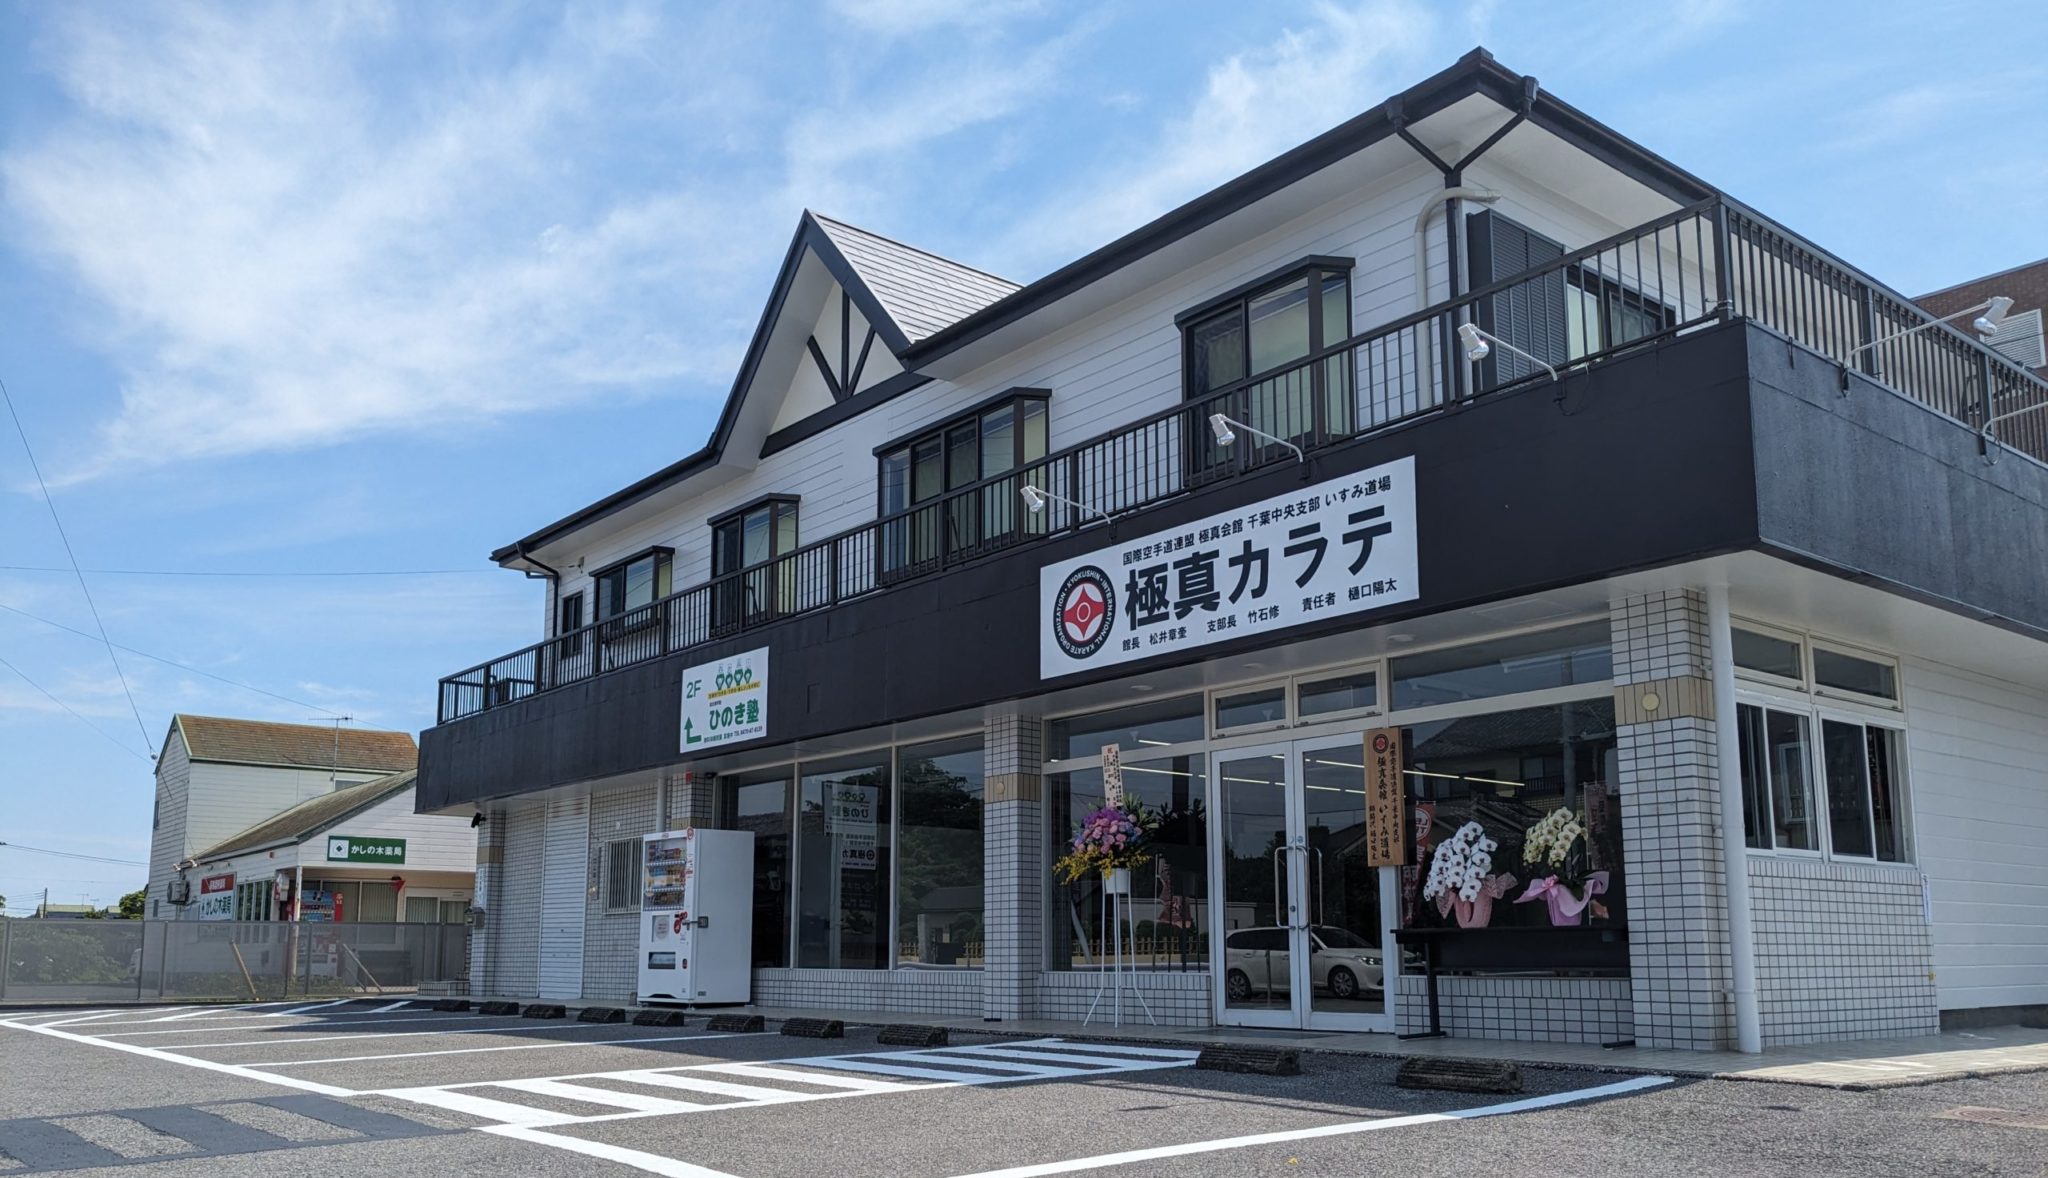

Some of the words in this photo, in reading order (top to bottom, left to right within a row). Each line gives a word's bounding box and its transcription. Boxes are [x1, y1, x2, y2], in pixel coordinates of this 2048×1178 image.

[1123, 533, 1195, 566] 国際空手道連盟
[1199, 518, 1243, 543] 極真会館
[1247, 496, 1320, 529] 千葉中央支部
[1325, 475, 1391, 506] いすみ道場
[1067, 569, 1101, 589] KYOKUSHIN
[1125, 504, 1392, 631] 極真カラテ
[1055, 592, 1071, 650] ORGANIZATION
[1094, 580, 1113, 643] INTERNATIONAL
[1122, 636, 1141, 652] 館長
[1207, 614, 1238, 633] 支部長
[1248, 605, 1280, 624] 竹石修
[1302, 592, 1336, 613] 責任者
[1348, 577, 1397, 601] 樋口陽太
[1070, 643, 1095, 655] KARATE
[686, 679, 702, 699] 2F
[709, 698, 760, 730] ひのき塾
[351, 845, 402, 856] かしの木薬局
